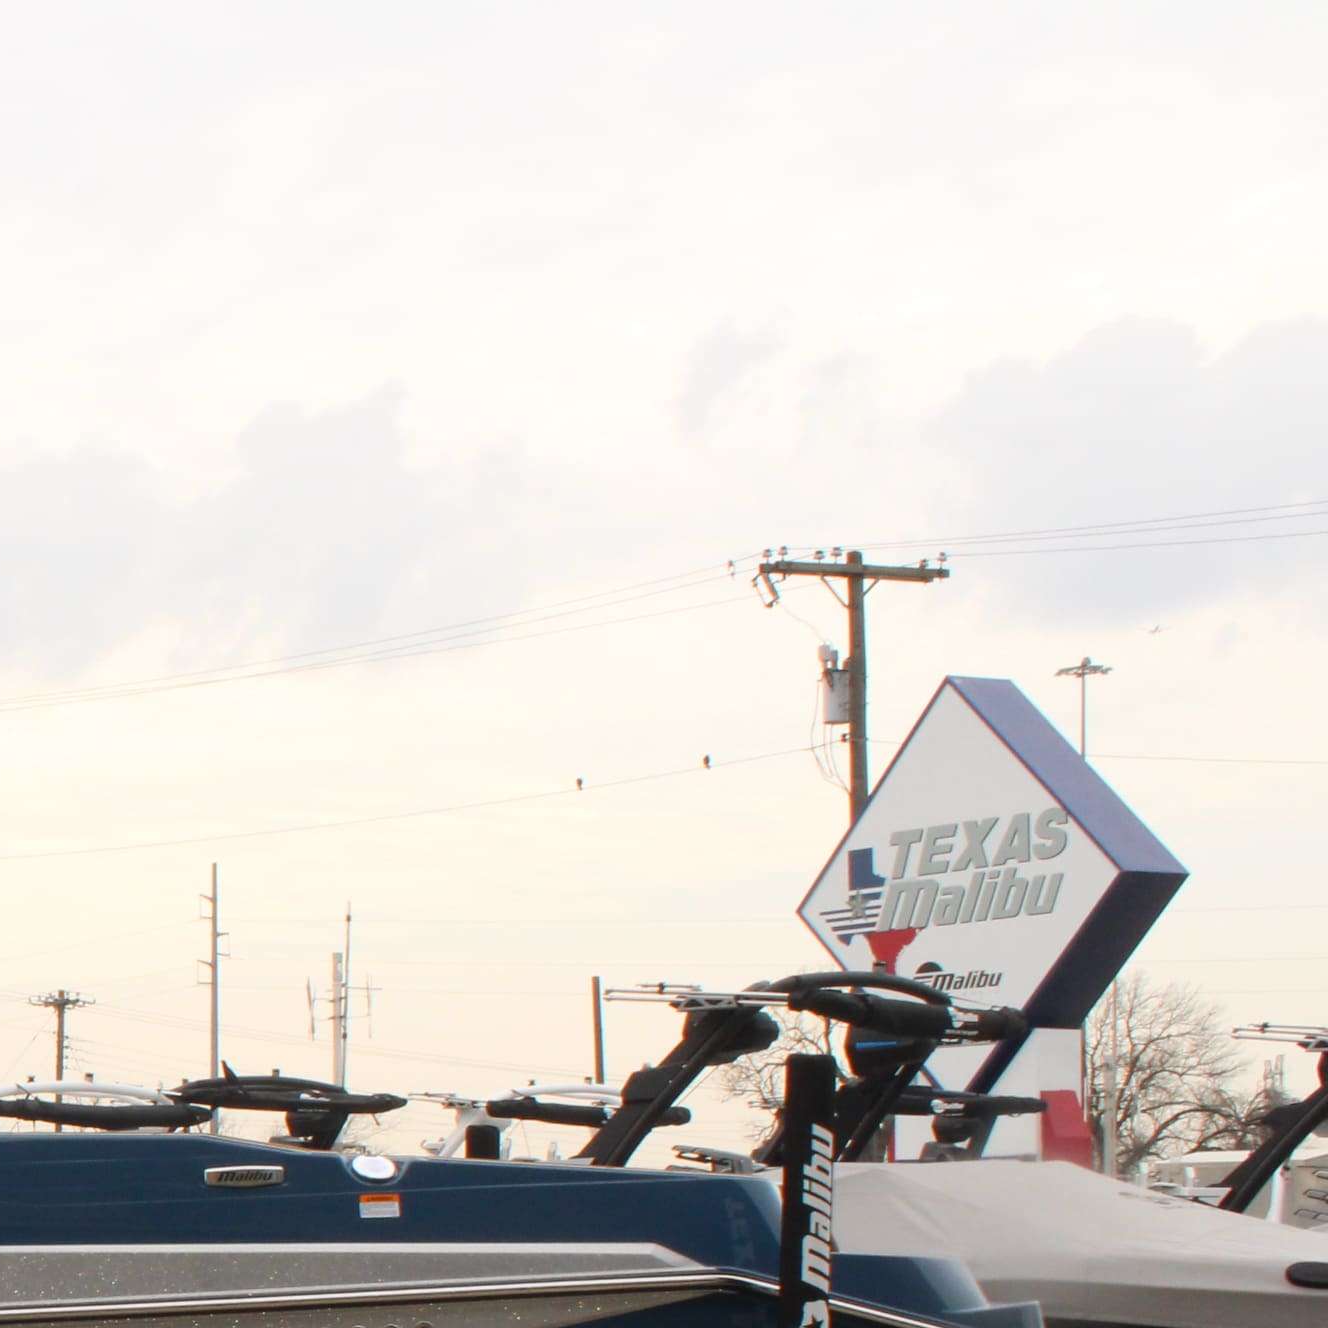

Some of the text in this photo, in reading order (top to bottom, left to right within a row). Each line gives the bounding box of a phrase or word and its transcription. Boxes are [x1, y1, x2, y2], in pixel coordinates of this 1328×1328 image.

[889, 807, 1069, 880] TEXAS
[875, 867, 1064, 932] Malibu
[932, 970, 1003, 991] Malibu
[801, 1123, 834, 1294] Malibu
